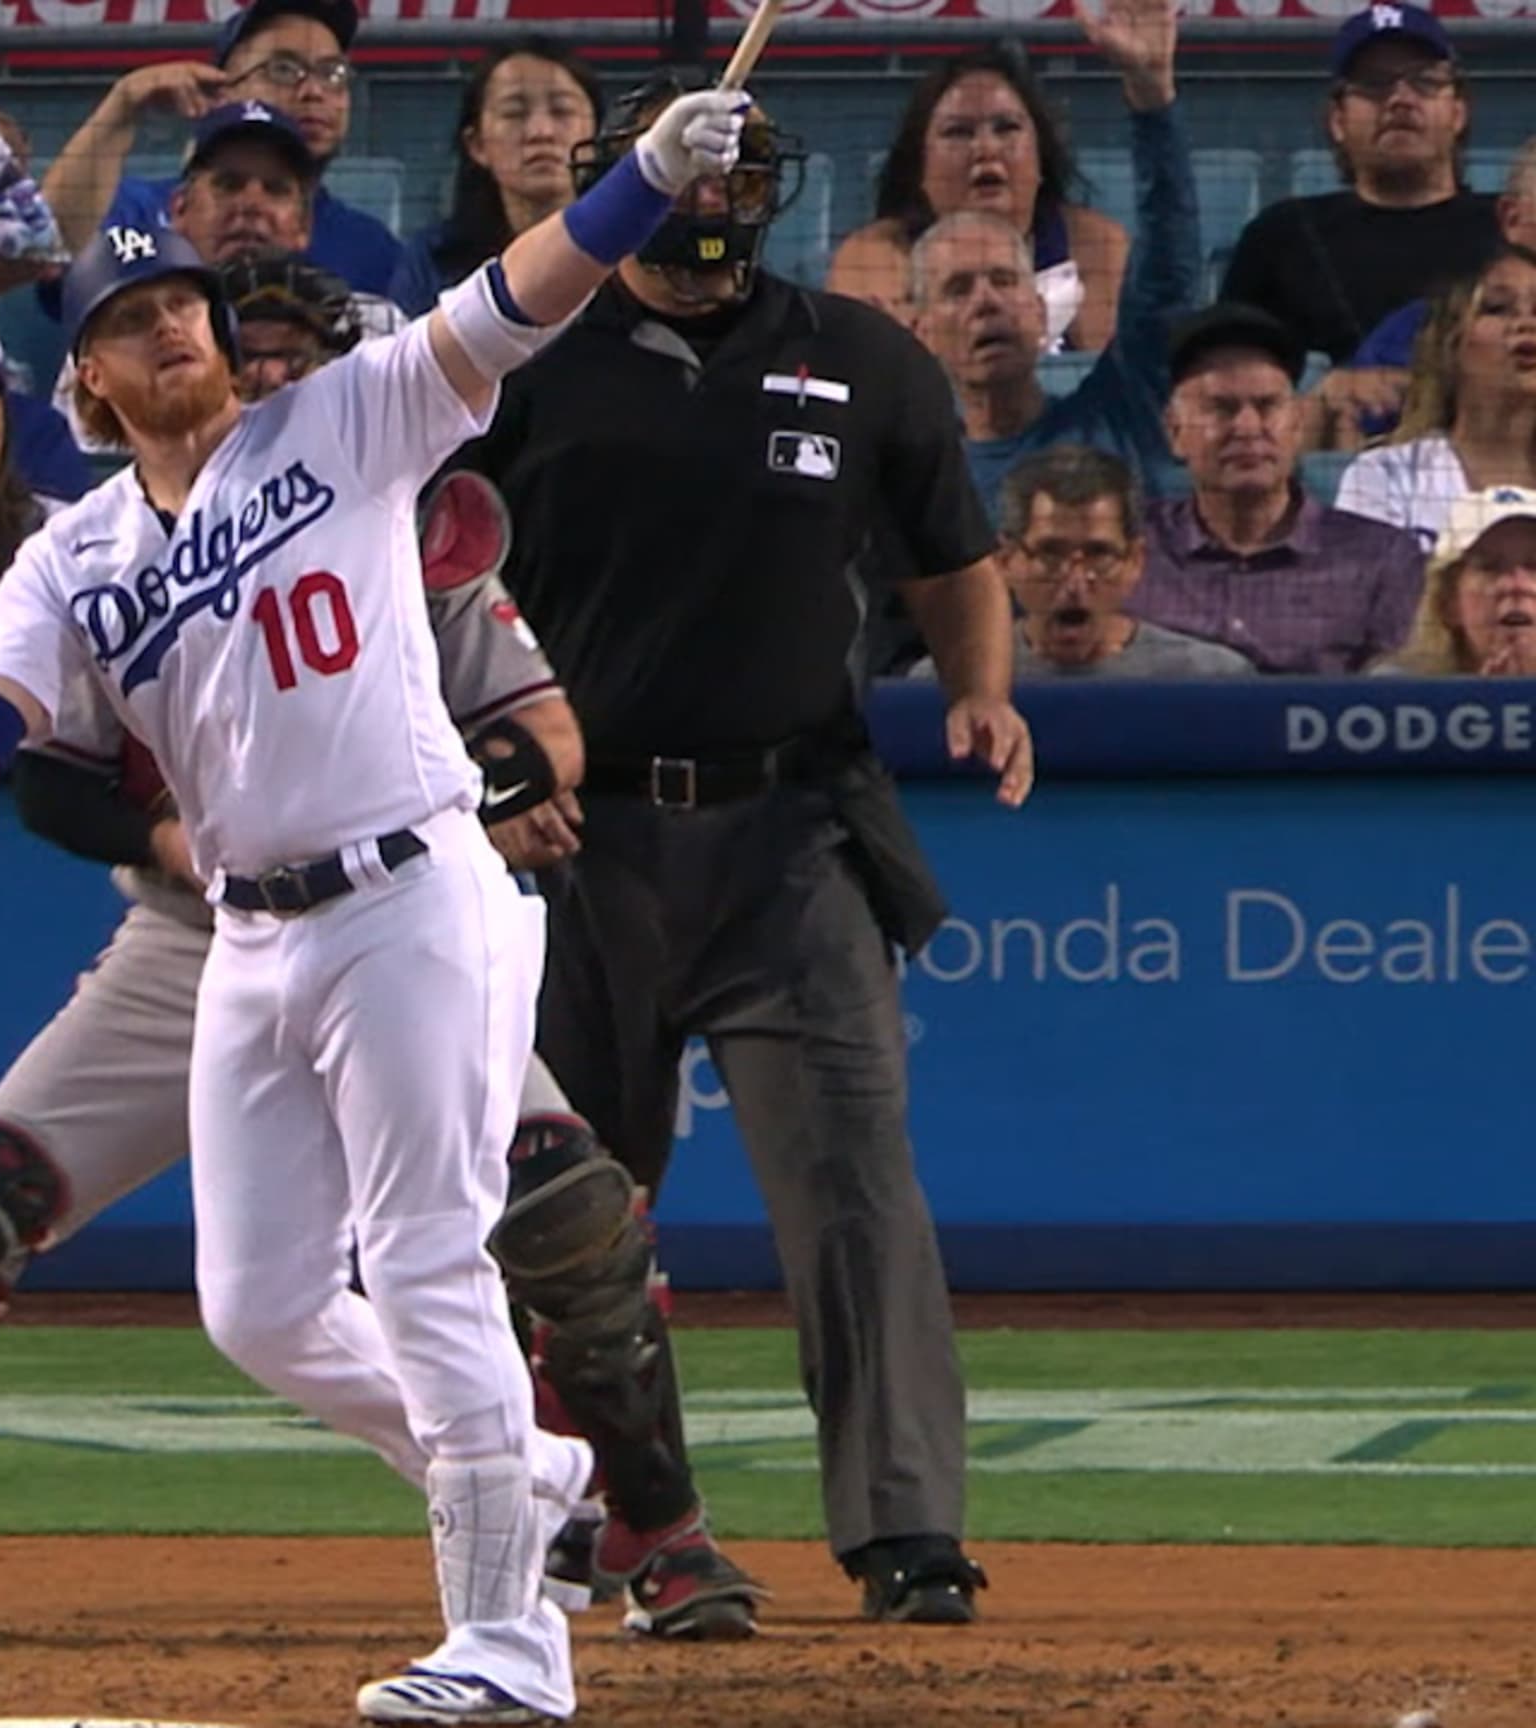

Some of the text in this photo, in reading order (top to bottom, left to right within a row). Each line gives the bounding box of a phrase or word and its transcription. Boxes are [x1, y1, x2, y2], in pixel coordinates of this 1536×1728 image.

[107, 226, 157, 262] LA
[71, 459, 332, 682] Dodgers
[251, 570, 359, 692] 10
[1286, 704, 1532, 753] DODGE
[888, 883, 1532, 983] onda Deale
